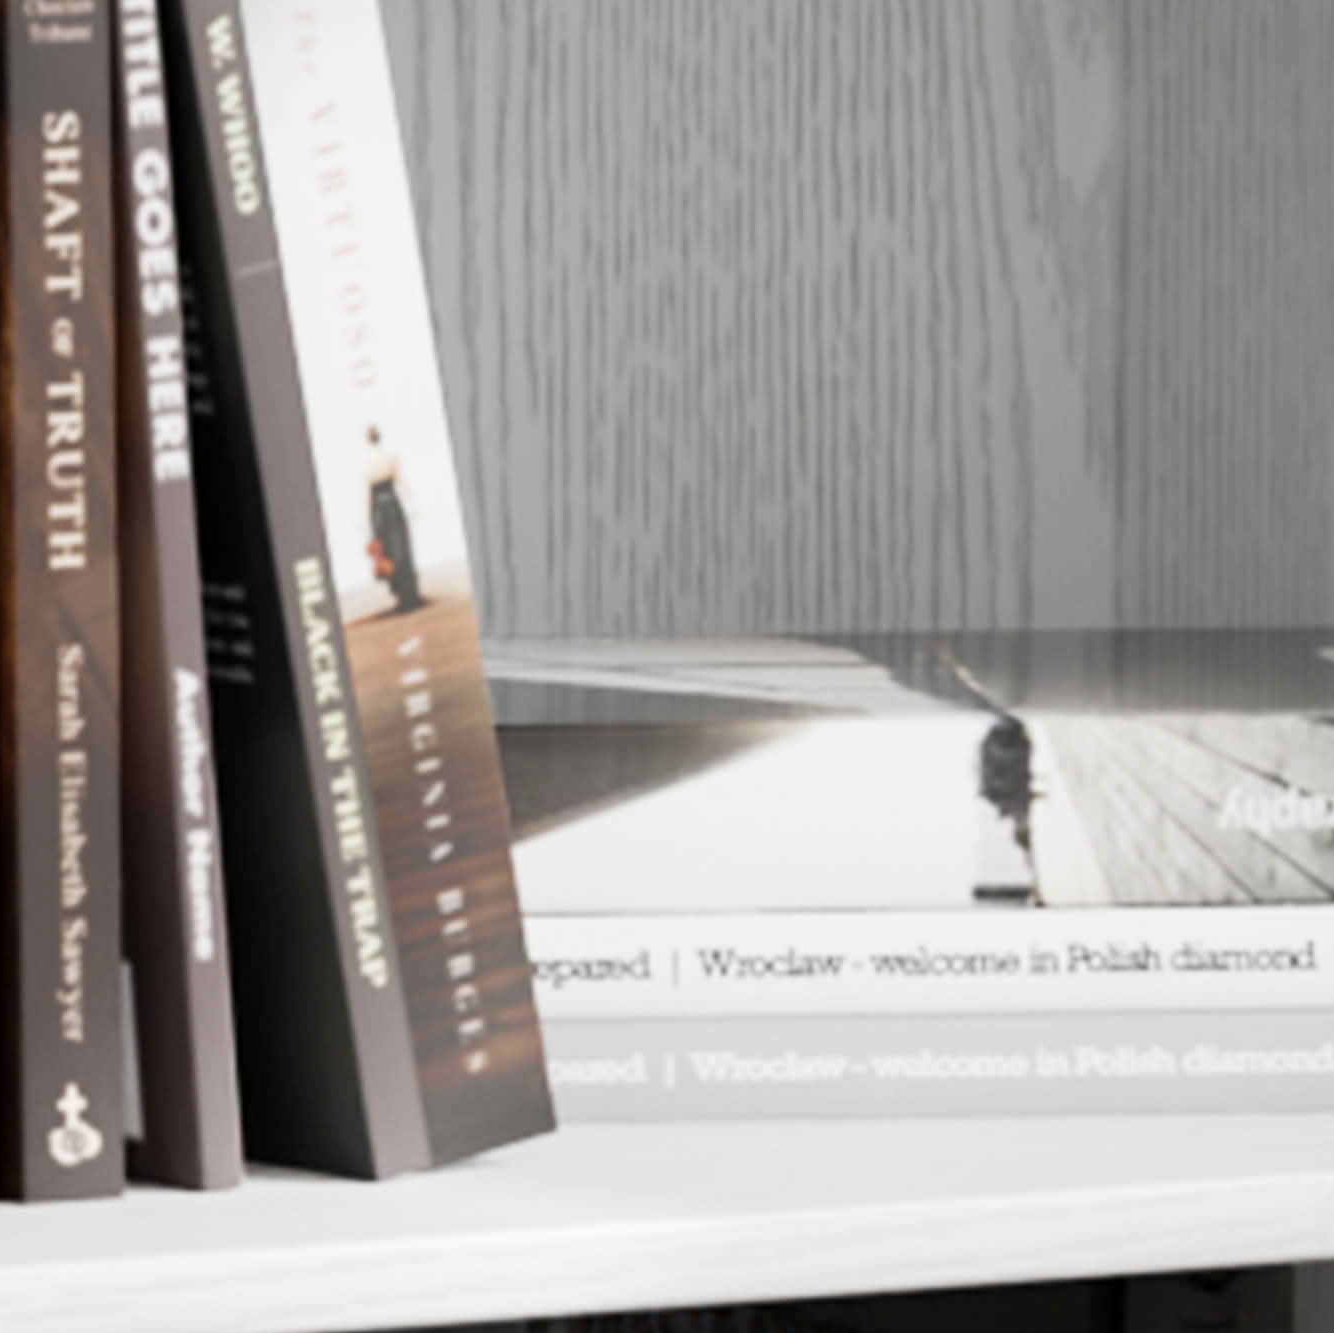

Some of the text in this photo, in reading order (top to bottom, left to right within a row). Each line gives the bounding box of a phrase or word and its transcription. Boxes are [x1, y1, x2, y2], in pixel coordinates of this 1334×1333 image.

[43, 110, 81, 301] SHAFT
[207, 15, 263, 217] W. WHOO
[132, 147, 179, 317] GOES
[45, 371, 86, 571] TRUTH
[147, 335, 191, 483] HERE
[56, 643, 88, 1043] Sarah Elisabeth Sawyer
[294, 557, 390, 990] BLACK IN THE TRAP
[395, 635, 455, 862] VIRGINIA
[870, 946, 1021, 978] welcome
[1029, 945, 1059, 975] in
[1067, 939, 1162, 976] Polish
[1171, 942, 1318, 974] diamond
[869, 1045, 1028, 1082] welcome
[1035, 1045, 1065, 1077] in
[1073, 1043, 1175, 1078] Polish
